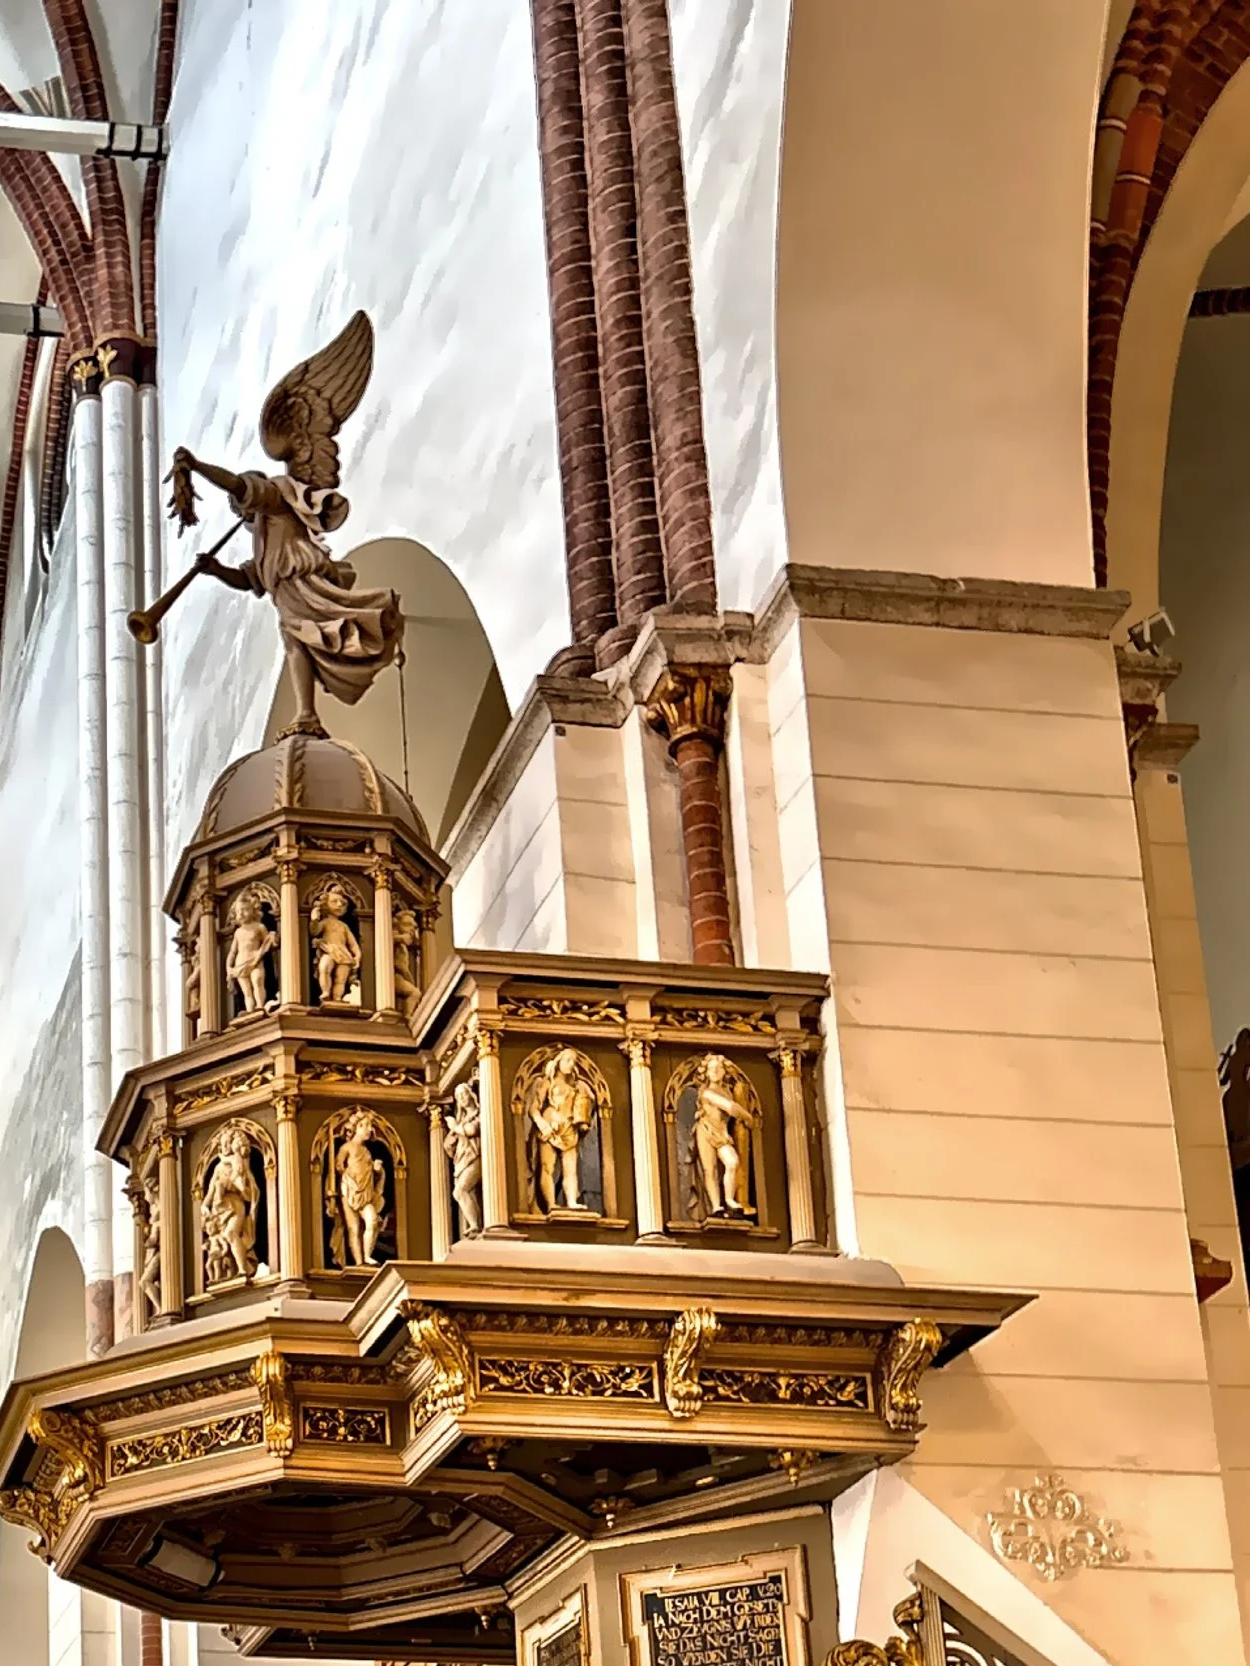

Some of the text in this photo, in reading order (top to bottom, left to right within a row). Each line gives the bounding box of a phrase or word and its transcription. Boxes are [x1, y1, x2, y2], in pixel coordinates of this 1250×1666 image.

[668, 1609, 700, 1626] NACH
[702, 1604, 731, 1621] DEM
[655, 1627, 681, 1641] VND
[659, 1640, 678, 1655] SIE
[679, 1637, 703, 1653] DAS
[706, 1630, 747, 1649] NICHT
[678, 1649, 728, 1666] WERDEN
[729, 1643, 750, 1660] SIE
[753, 1640, 776, 1657] DIE
